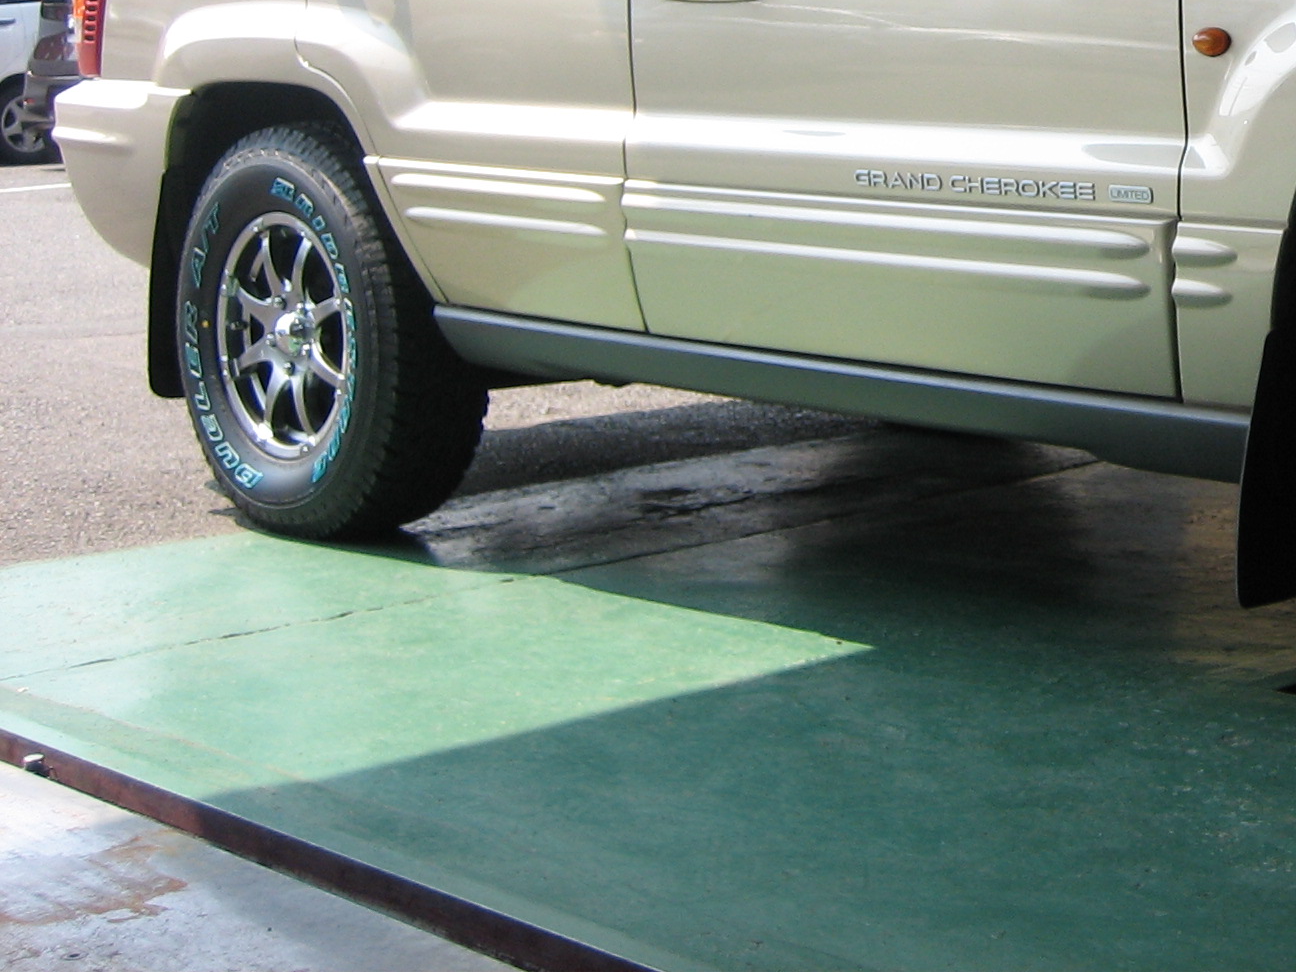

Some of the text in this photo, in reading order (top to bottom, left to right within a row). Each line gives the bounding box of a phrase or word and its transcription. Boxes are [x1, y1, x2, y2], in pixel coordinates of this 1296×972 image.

[855, 169, 1151, 201] GRAND CHEROKEE LIMITED
